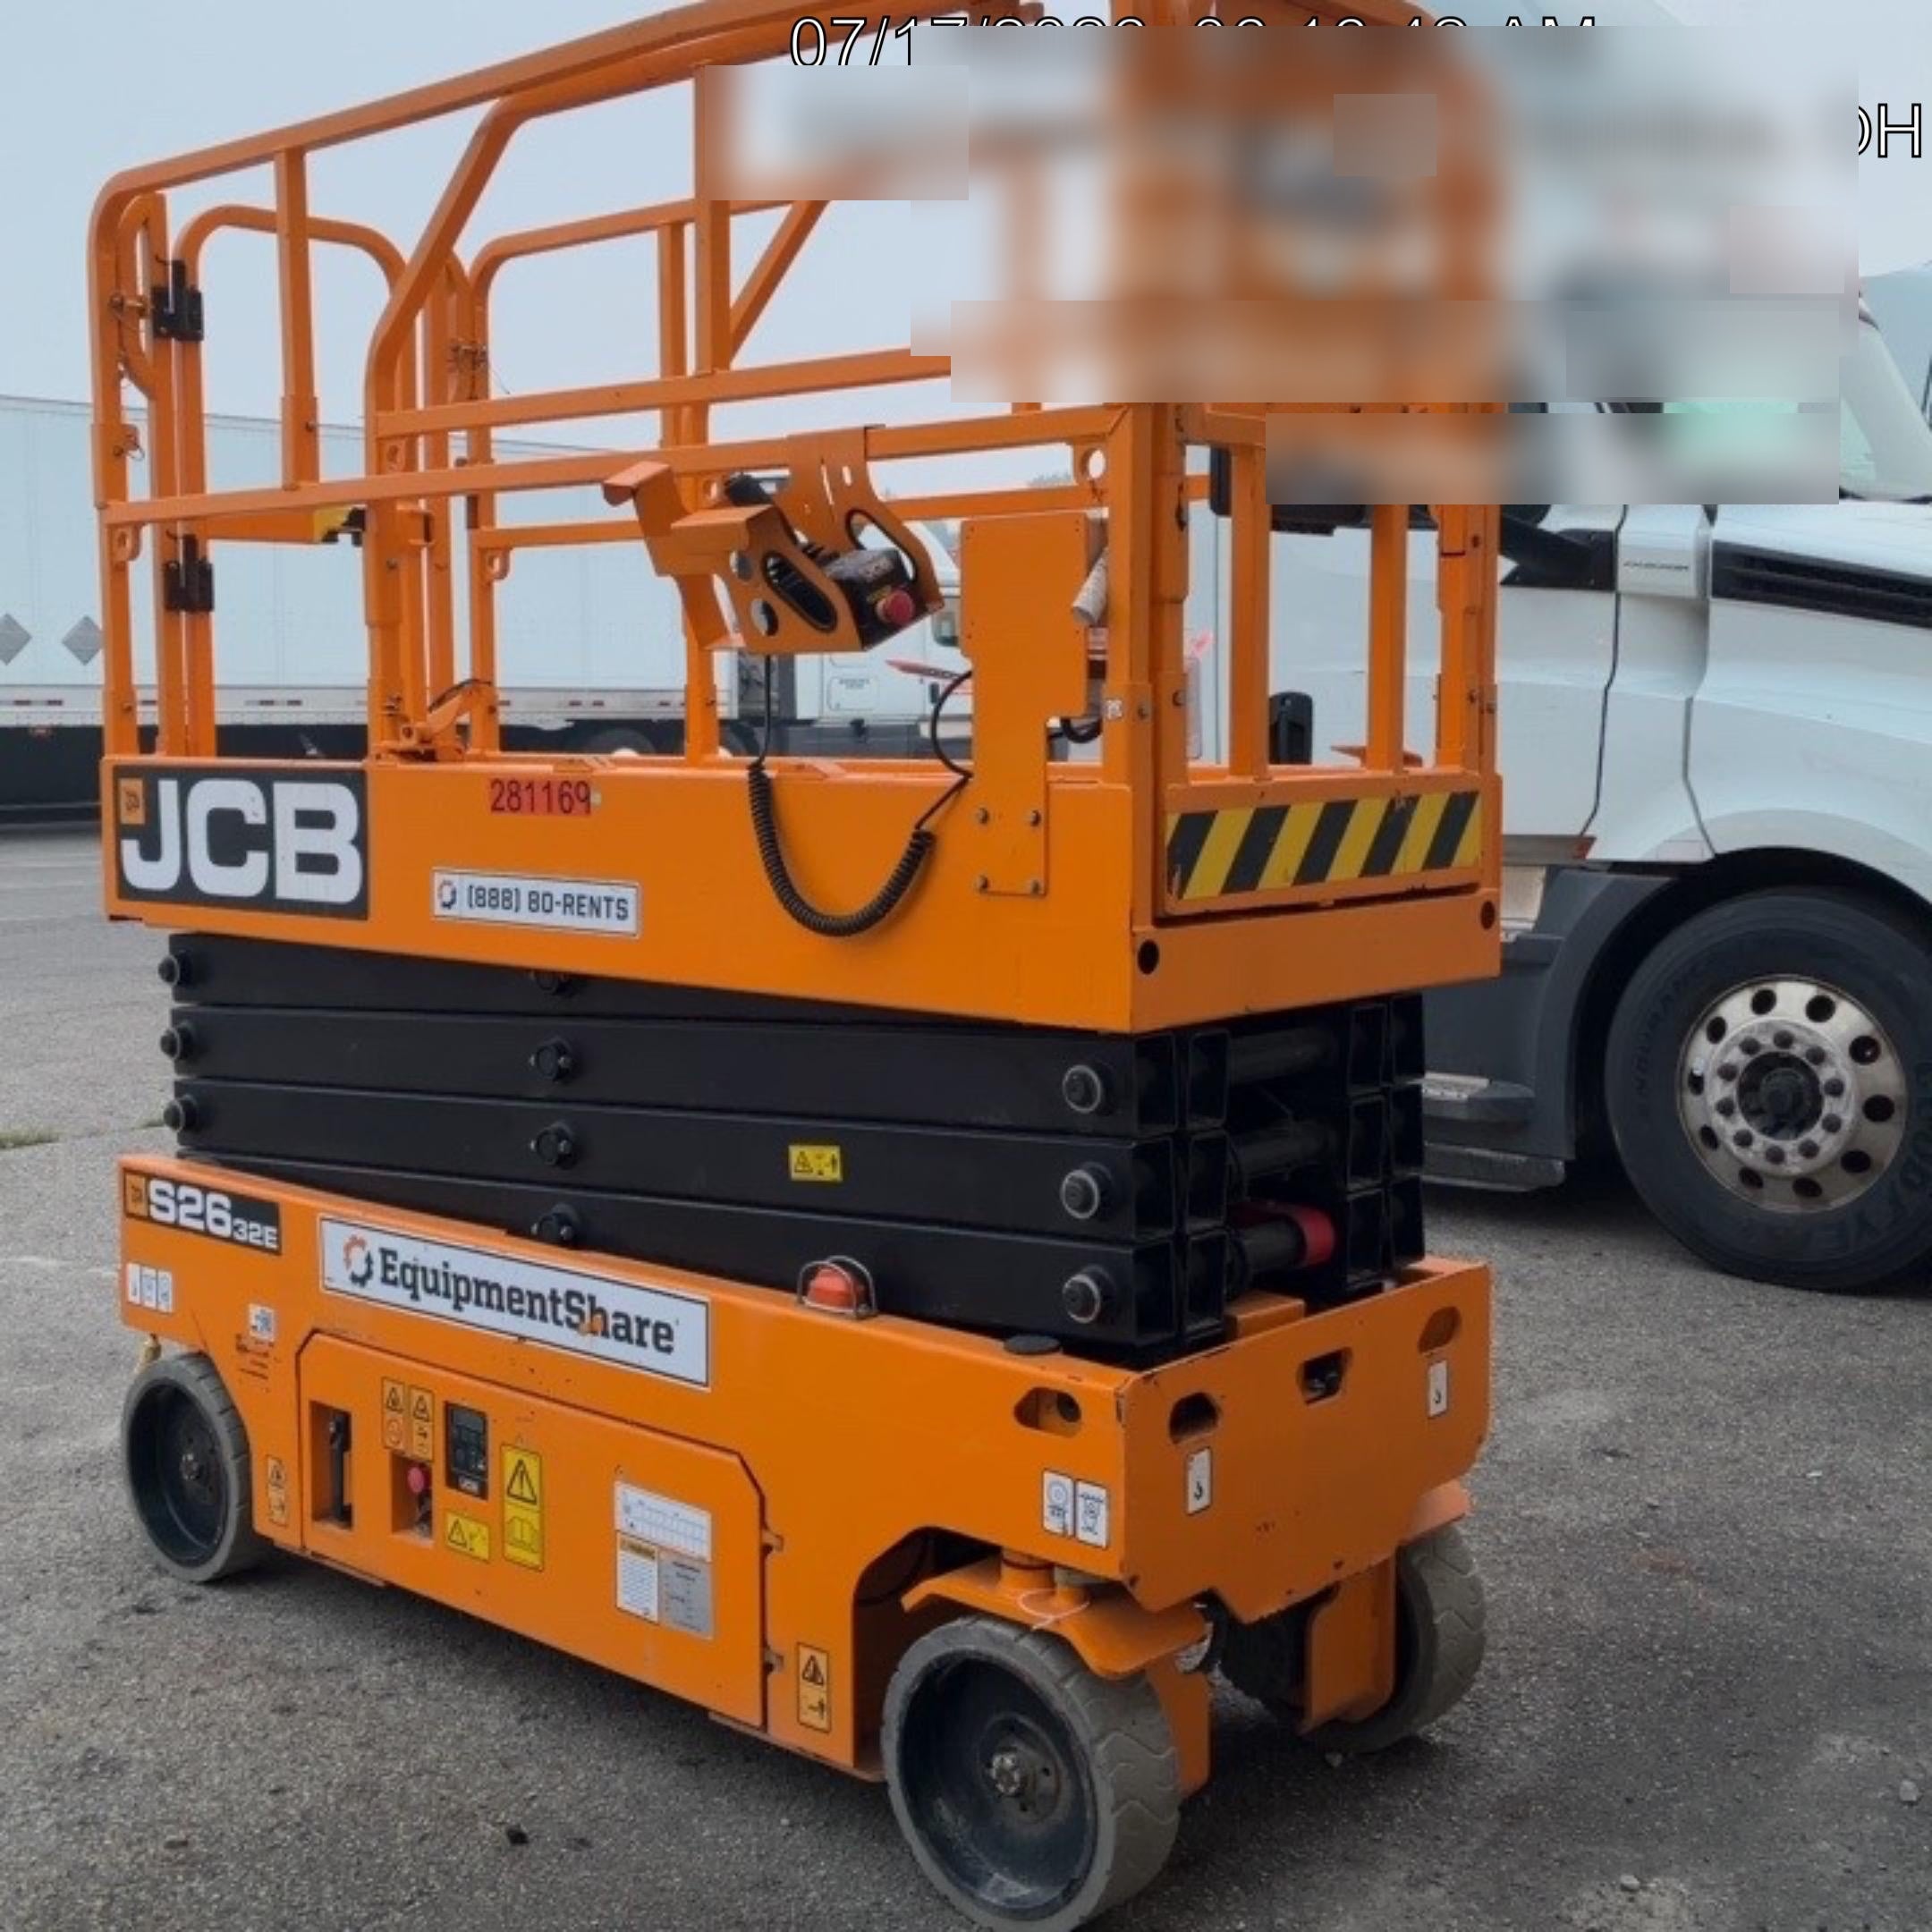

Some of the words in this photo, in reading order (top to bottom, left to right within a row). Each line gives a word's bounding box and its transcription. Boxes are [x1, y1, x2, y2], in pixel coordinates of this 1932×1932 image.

[490, 778, 591, 815] 281169
[121, 777, 362, 904] JCB
[467, 884, 521, 912] (888)
[527, 890, 630, 921] 80-RENTS
[379, 1247, 676, 1354] EquipmentShare
